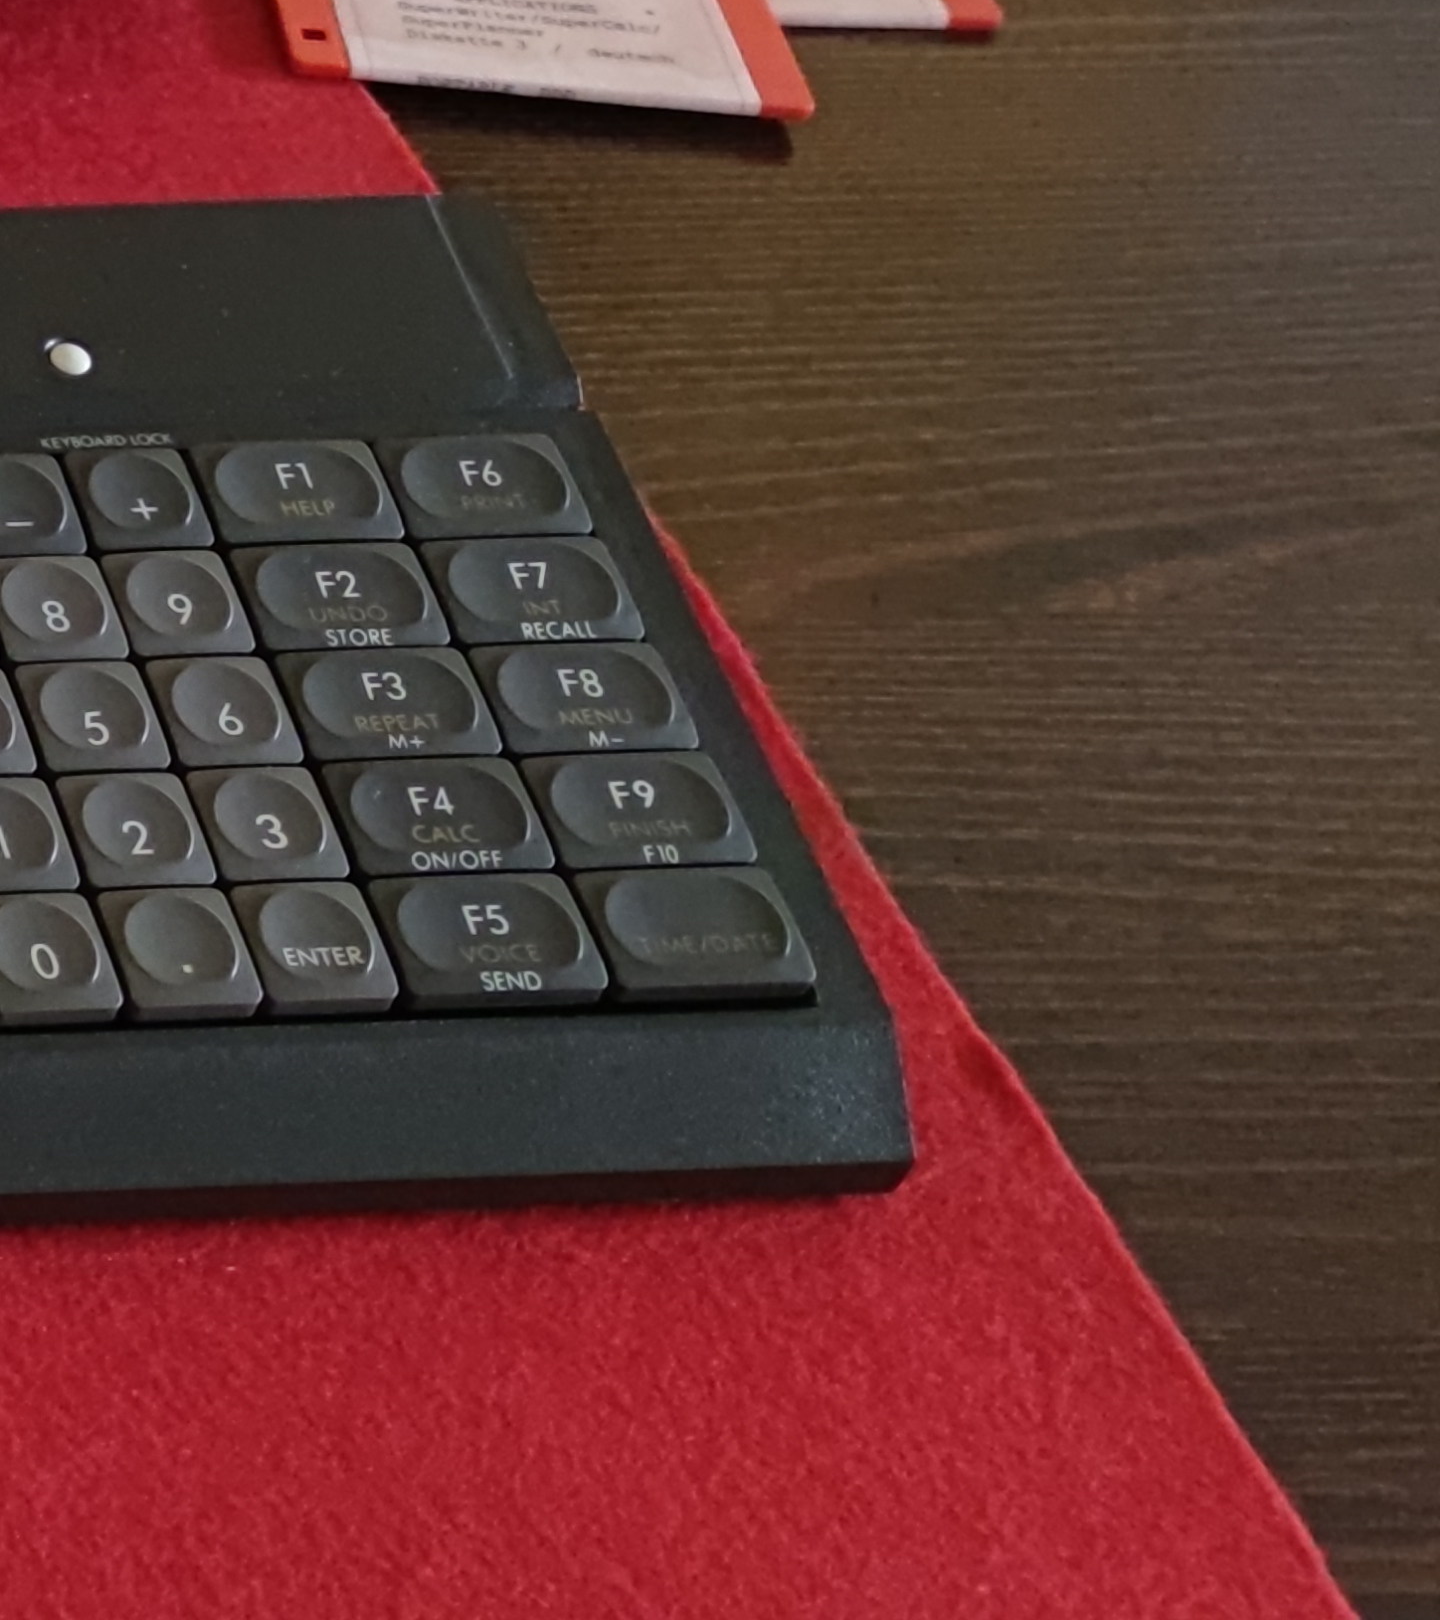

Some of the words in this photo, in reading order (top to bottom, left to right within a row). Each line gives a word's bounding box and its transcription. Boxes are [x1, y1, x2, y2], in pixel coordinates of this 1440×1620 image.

[40, 434, 125, 449] KEYBOARD
[129, 432, 172, 446] LOCK
[274, 462, 313, 490] F1
[458, 459, 503, 487] F6
[280, 498, 336, 517] HELP
[315, 570, 361, 598] F2
[508, 561, 547, 589] F7
[324, 627, 393, 647] STORE
[520, 621, 597, 640] RECALL
[361, 671, 407, 701] F3
[557, 668, 604, 698] F8
[353, 713, 438, 733] REPEAT
[558, 707, 633, 725] MENU
[388, 734, 424, 749] M+
[407, 786, 454, 816] F4
[608, 779, 655, 809] F9
[411, 823, 480, 844] CALC
[410, 849, 502, 871] ON/OFF
[642, 843, 680, 864] F10
[461, 903, 510, 935] F5
[281, 945, 363, 967] ENTER
[459, 941, 542, 964] VOICE
[480, 970, 542, 991] SEND
